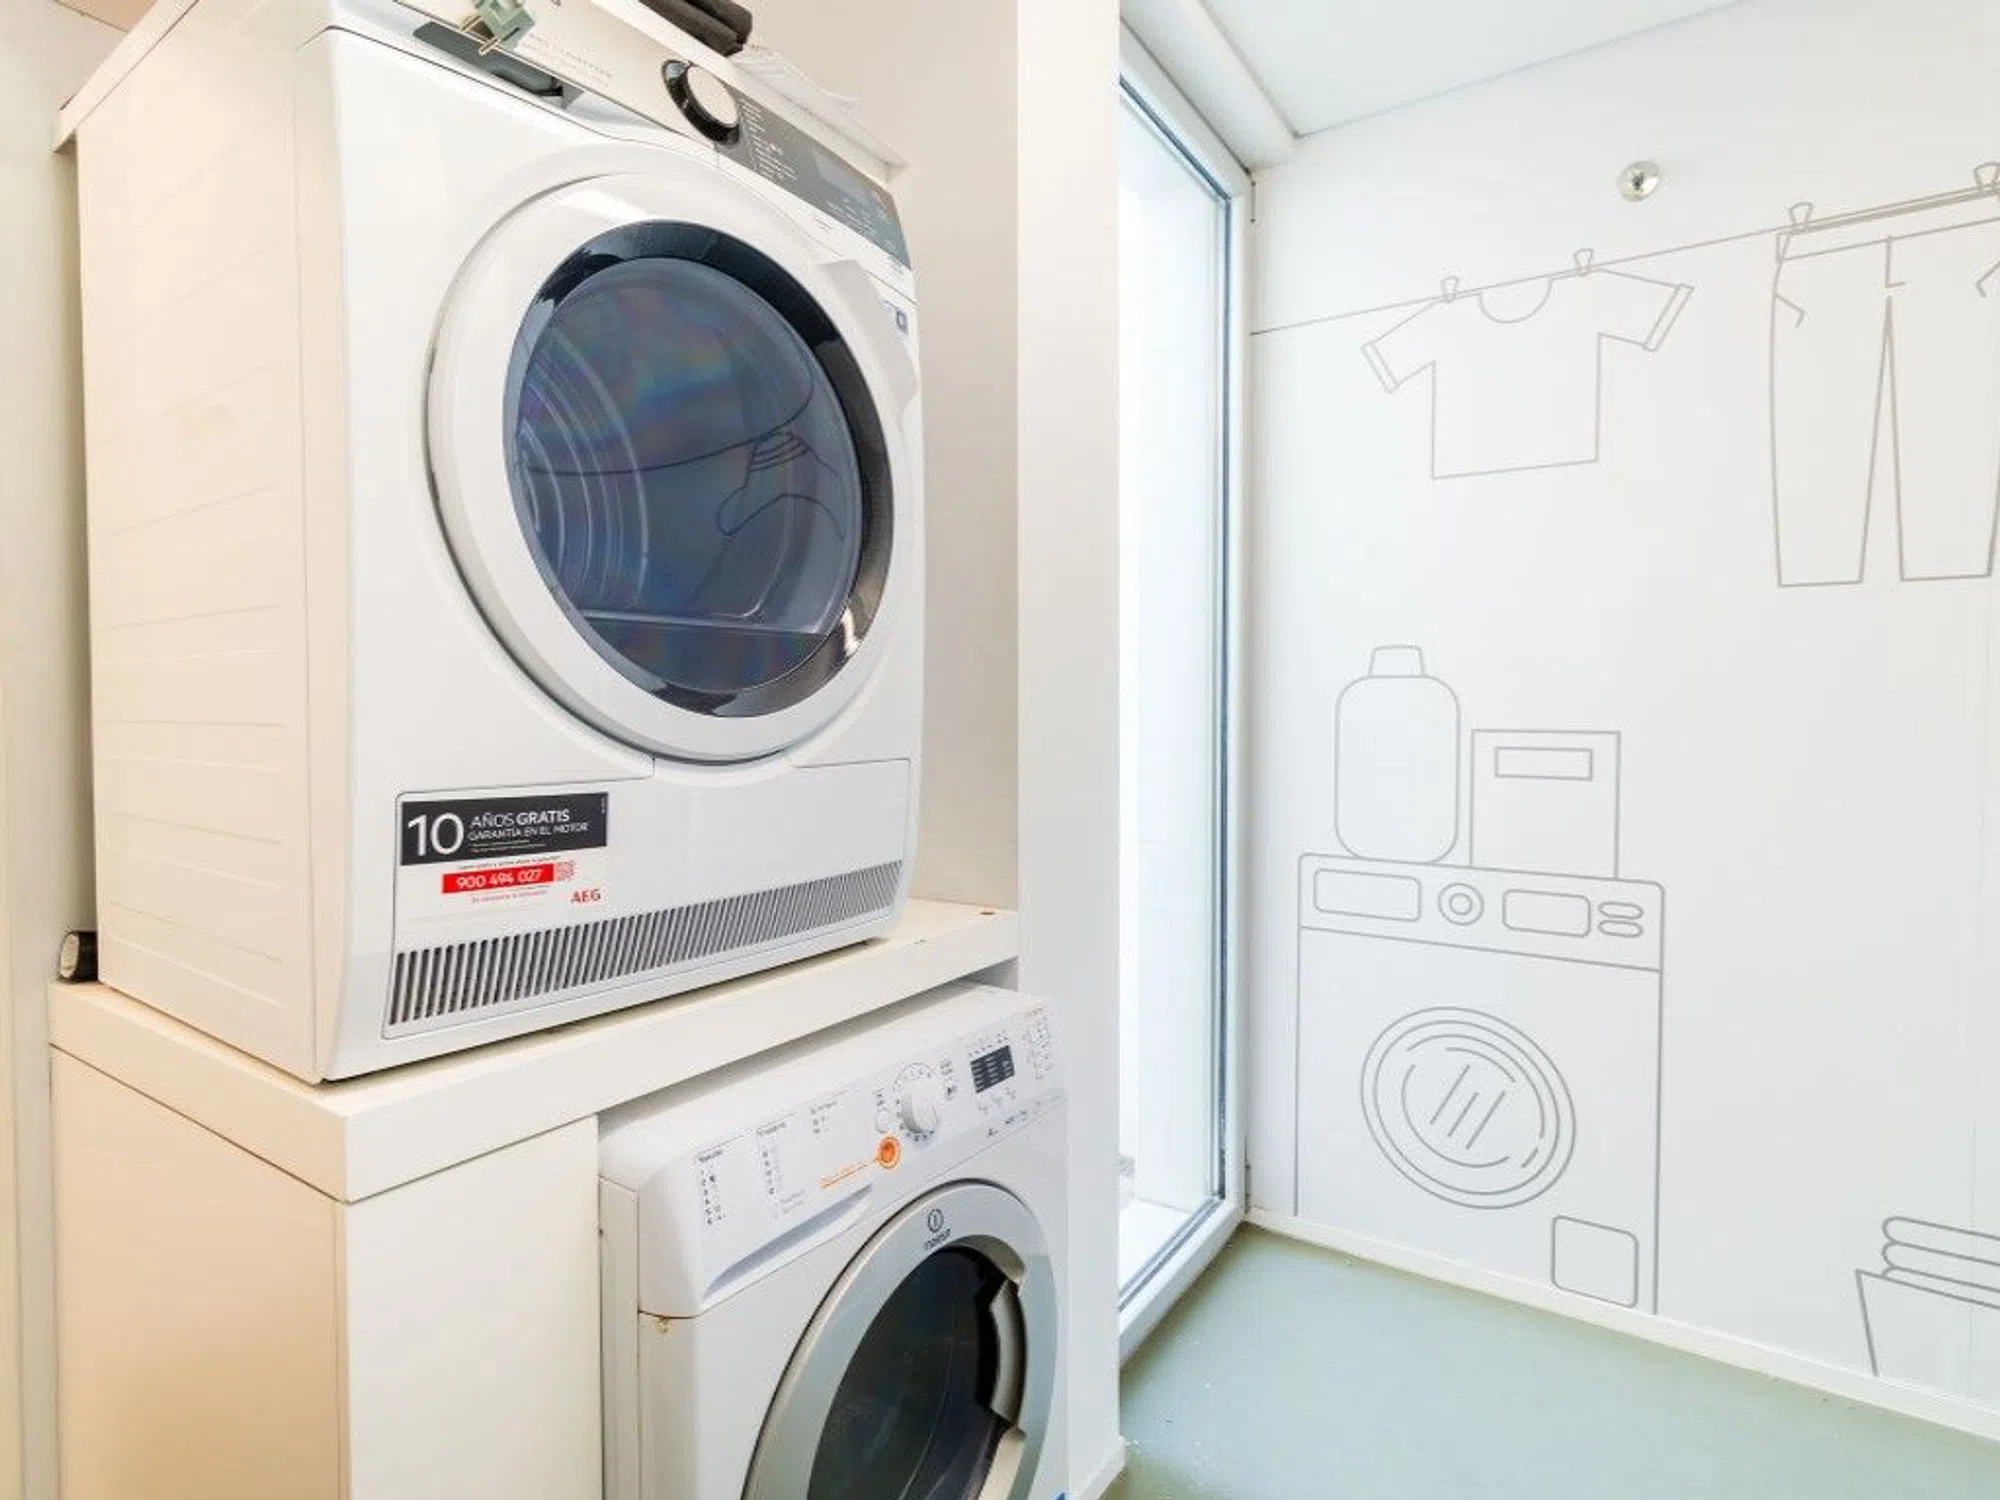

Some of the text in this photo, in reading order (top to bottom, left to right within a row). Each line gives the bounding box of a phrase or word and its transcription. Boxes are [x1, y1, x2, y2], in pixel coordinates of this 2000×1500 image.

[471, 809, 570, 828] AÑOS GRATIS
[408, 813, 464, 856] 10
[467, 823, 588, 841] GARANTÍA EN EL MOTOR
[456, 870, 542, 889] 900 494 027
[571, 889, 601, 903] AEG
